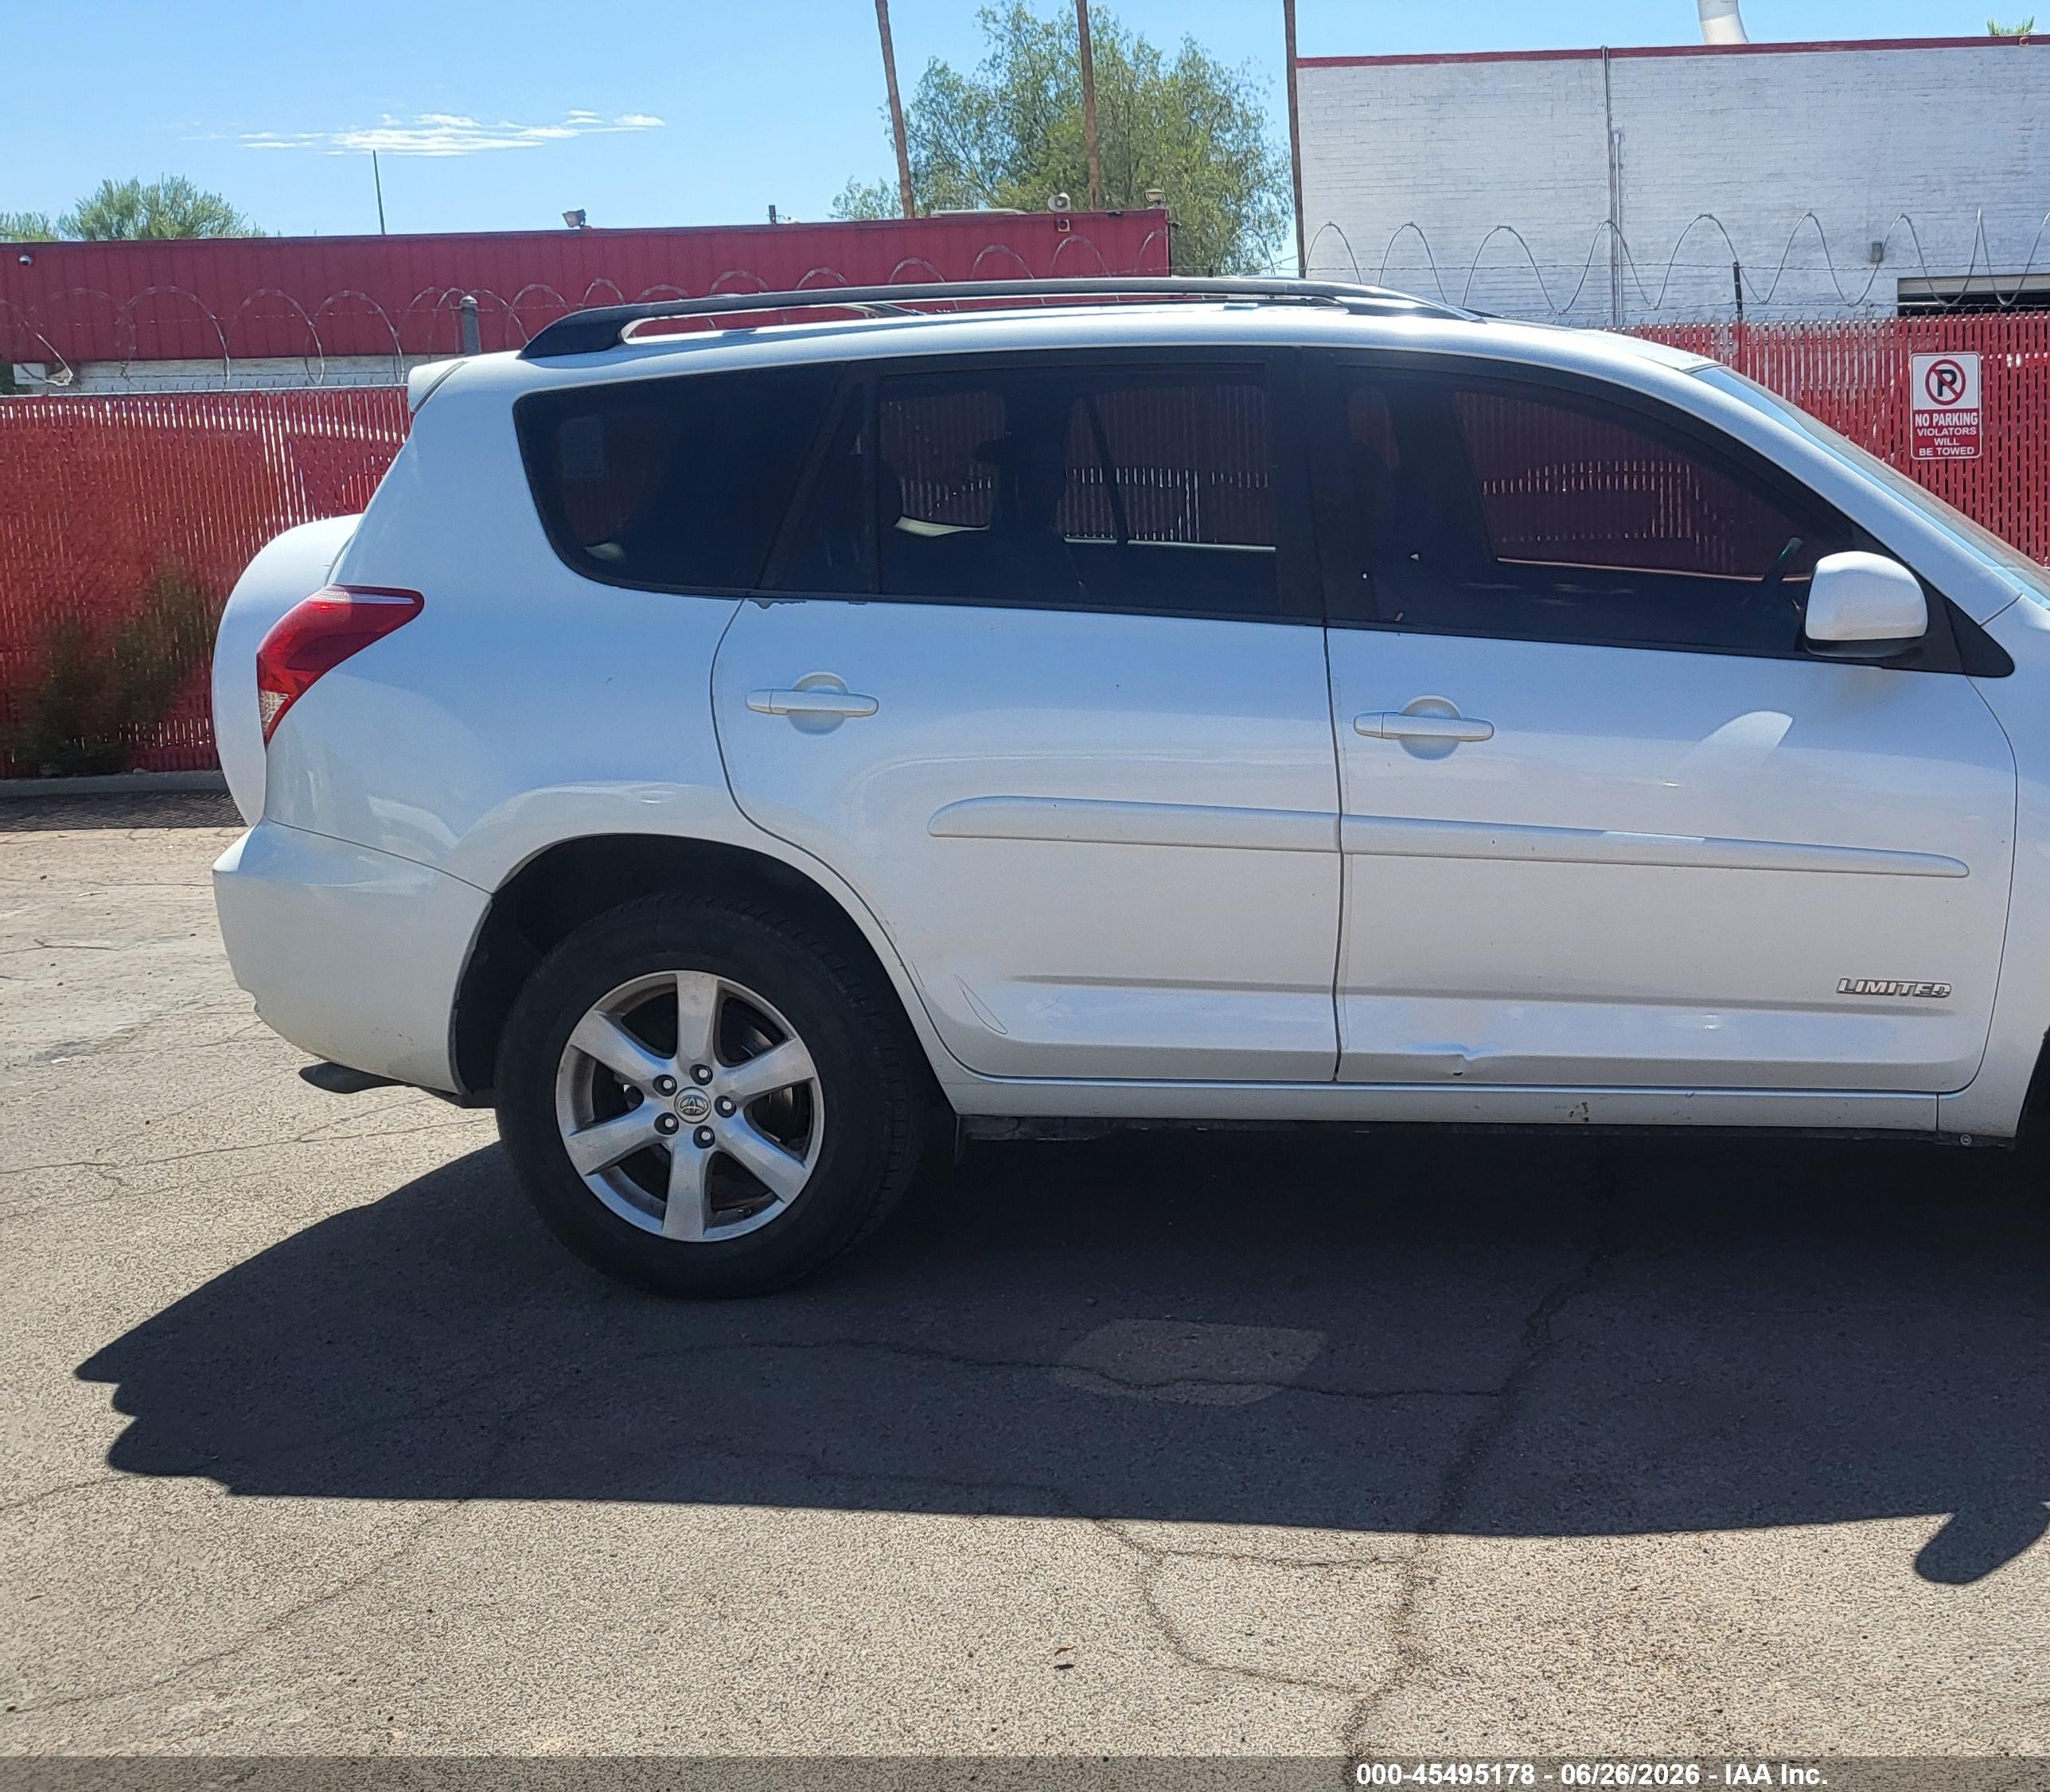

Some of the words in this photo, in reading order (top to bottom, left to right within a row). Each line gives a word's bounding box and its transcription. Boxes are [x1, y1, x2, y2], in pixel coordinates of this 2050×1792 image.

[1915, 413, 1930, 427] NO
[1932, 412, 1978, 427] PARKING
[1916, 427, 1977, 436] VIOLATORS
[1936, 446, 1974, 455] TOWED
[1837, 978, 1951, 998] LIMITED
